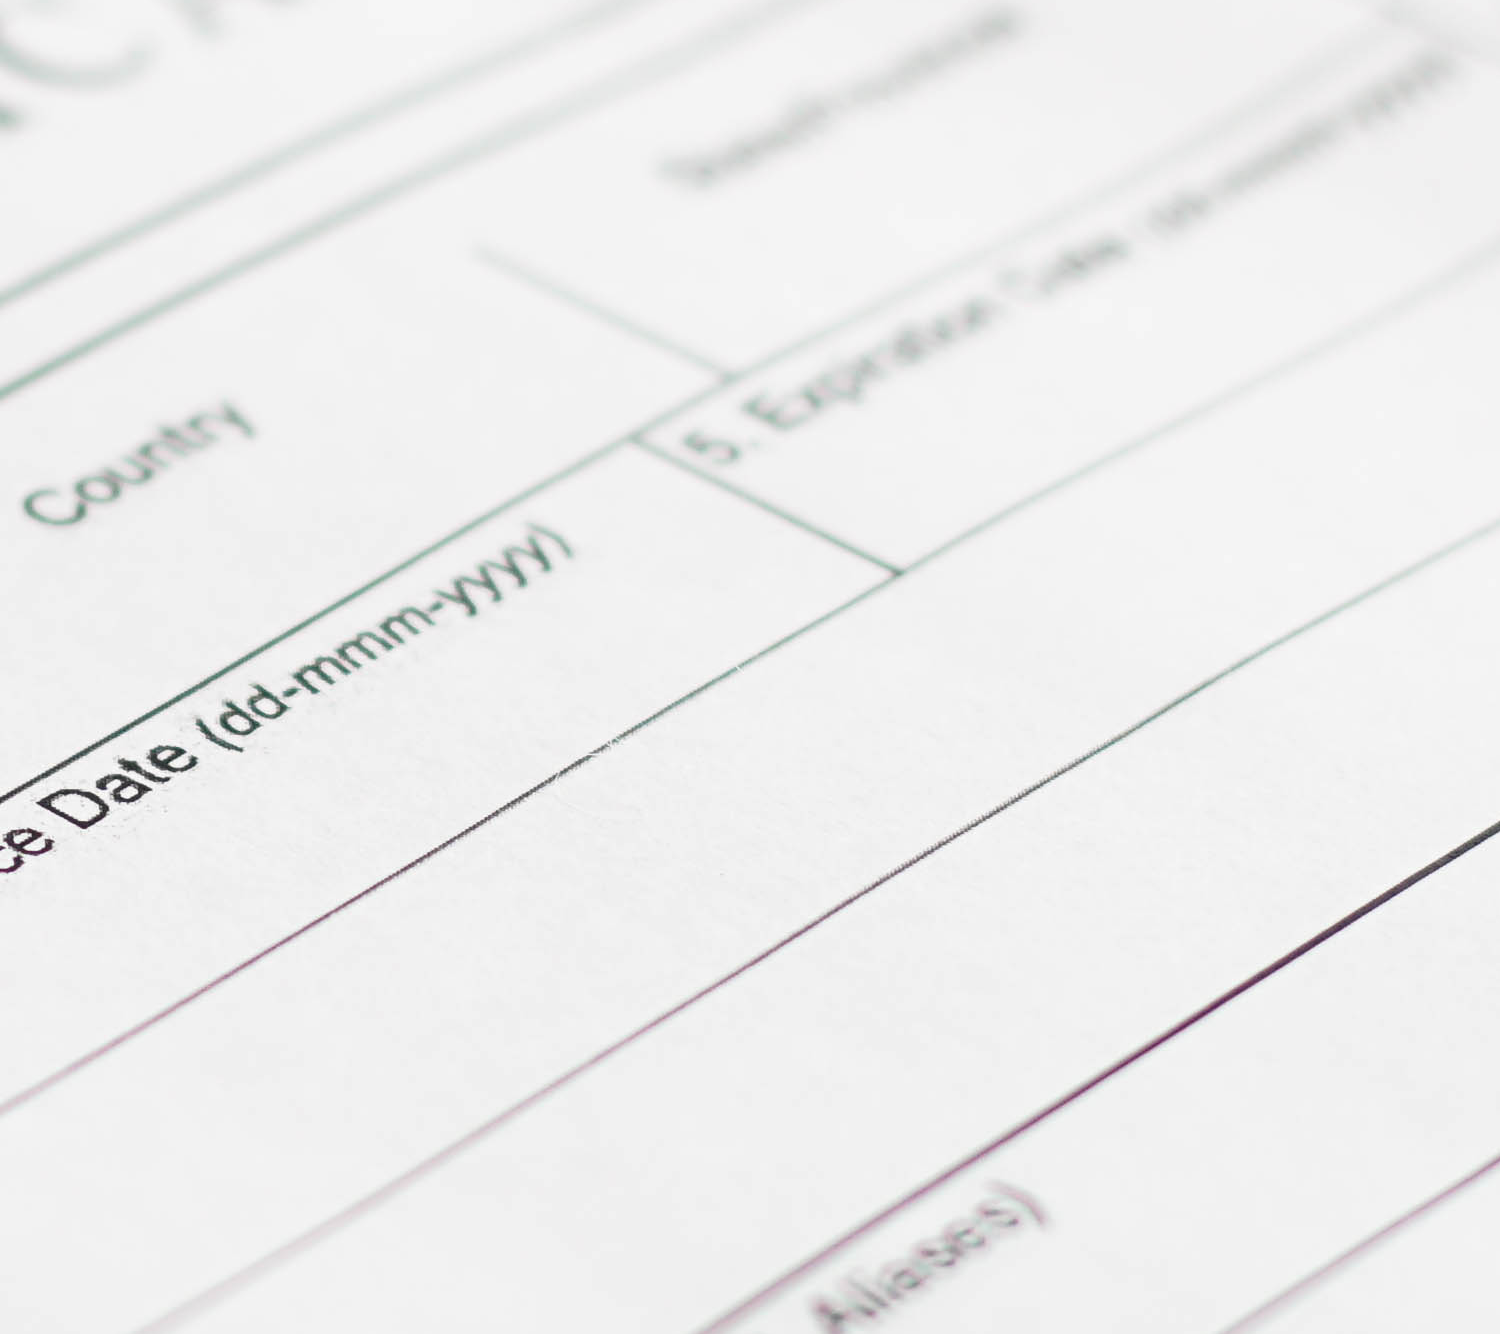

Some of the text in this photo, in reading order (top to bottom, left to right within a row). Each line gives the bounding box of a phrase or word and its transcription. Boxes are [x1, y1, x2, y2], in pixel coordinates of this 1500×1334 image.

[22, 397, 258, 529] Country
[683, 429, 760, 464] 5.
[37, 740, 199, 829] Date
[201, 522, 576, 752] (dd-mmm-yyyy)
